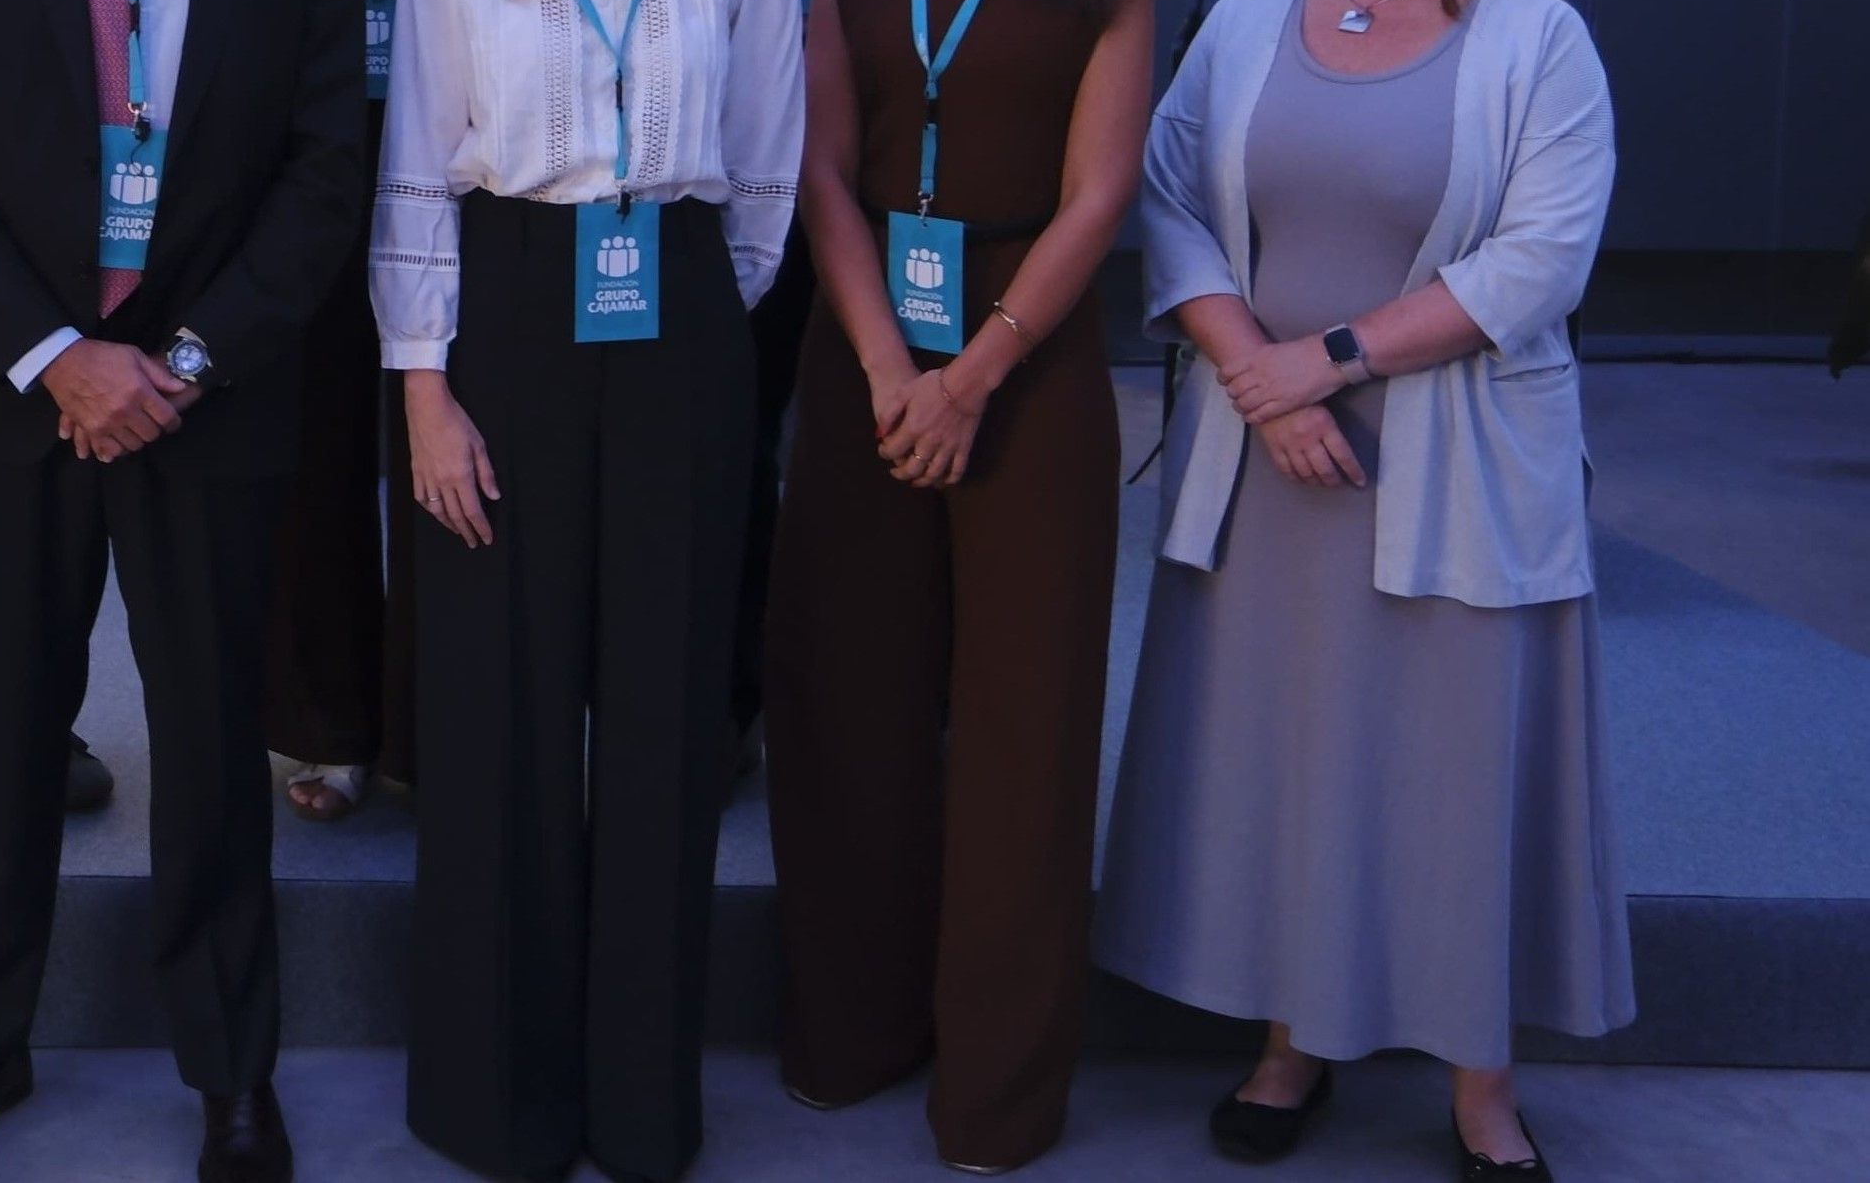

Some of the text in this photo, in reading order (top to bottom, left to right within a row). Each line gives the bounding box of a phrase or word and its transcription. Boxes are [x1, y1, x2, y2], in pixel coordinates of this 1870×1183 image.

[105, 216, 154, 230] GRUPO
[99, 226, 152, 241] AJAMA
[595, 289, 640, 302] GRUPO
[586, 299, 648, 315] CAJAMAR
[903, 297, 944, 314] GRUPO
[897, 306, 951, 326] CAJAMAR
